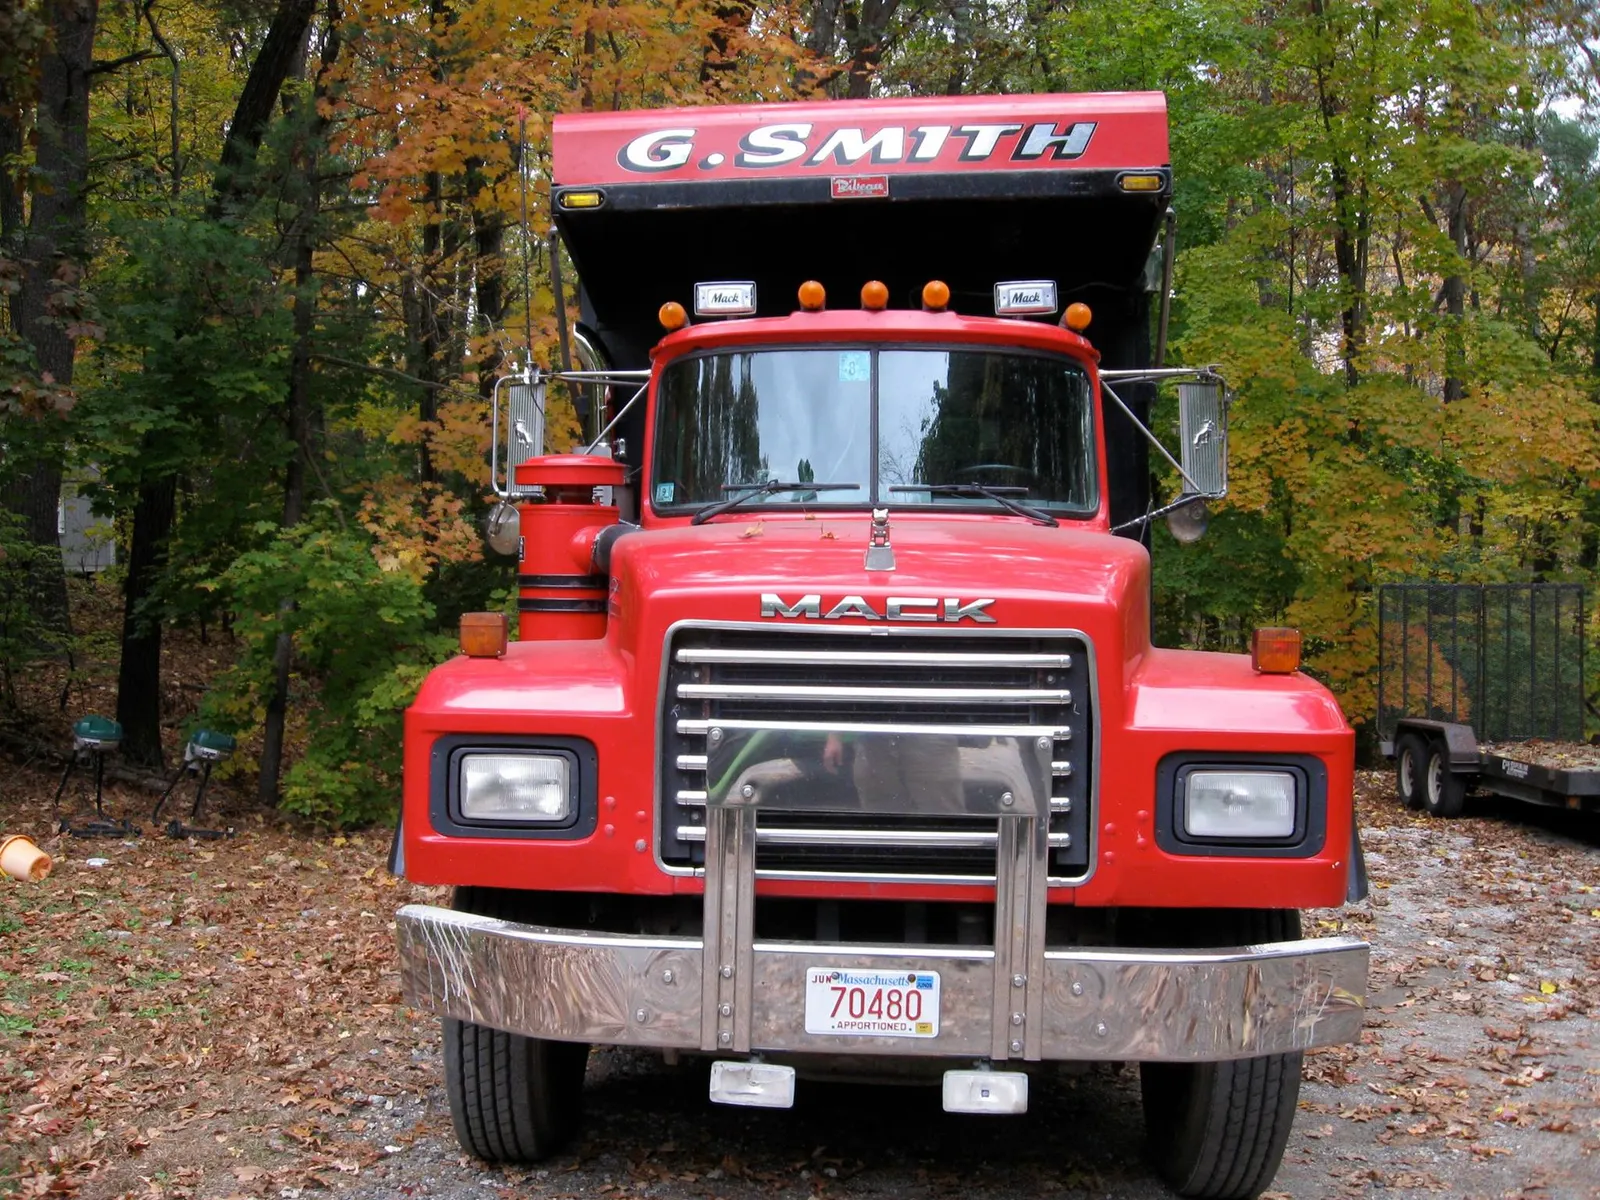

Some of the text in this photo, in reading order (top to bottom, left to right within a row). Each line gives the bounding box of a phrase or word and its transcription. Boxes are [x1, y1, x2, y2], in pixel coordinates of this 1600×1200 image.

[711, 293, 740, 304] Mack
[1011, 292, 1041, 304] Mack
[760, 593, 998, 623] MACK
[811, 974, 832, 984] JUN
[837, 972, 911, 987] Massachusetts
[830, 986, 922, 1021] 70480
[836, 1020, 908, 1032] APPORTIONED
